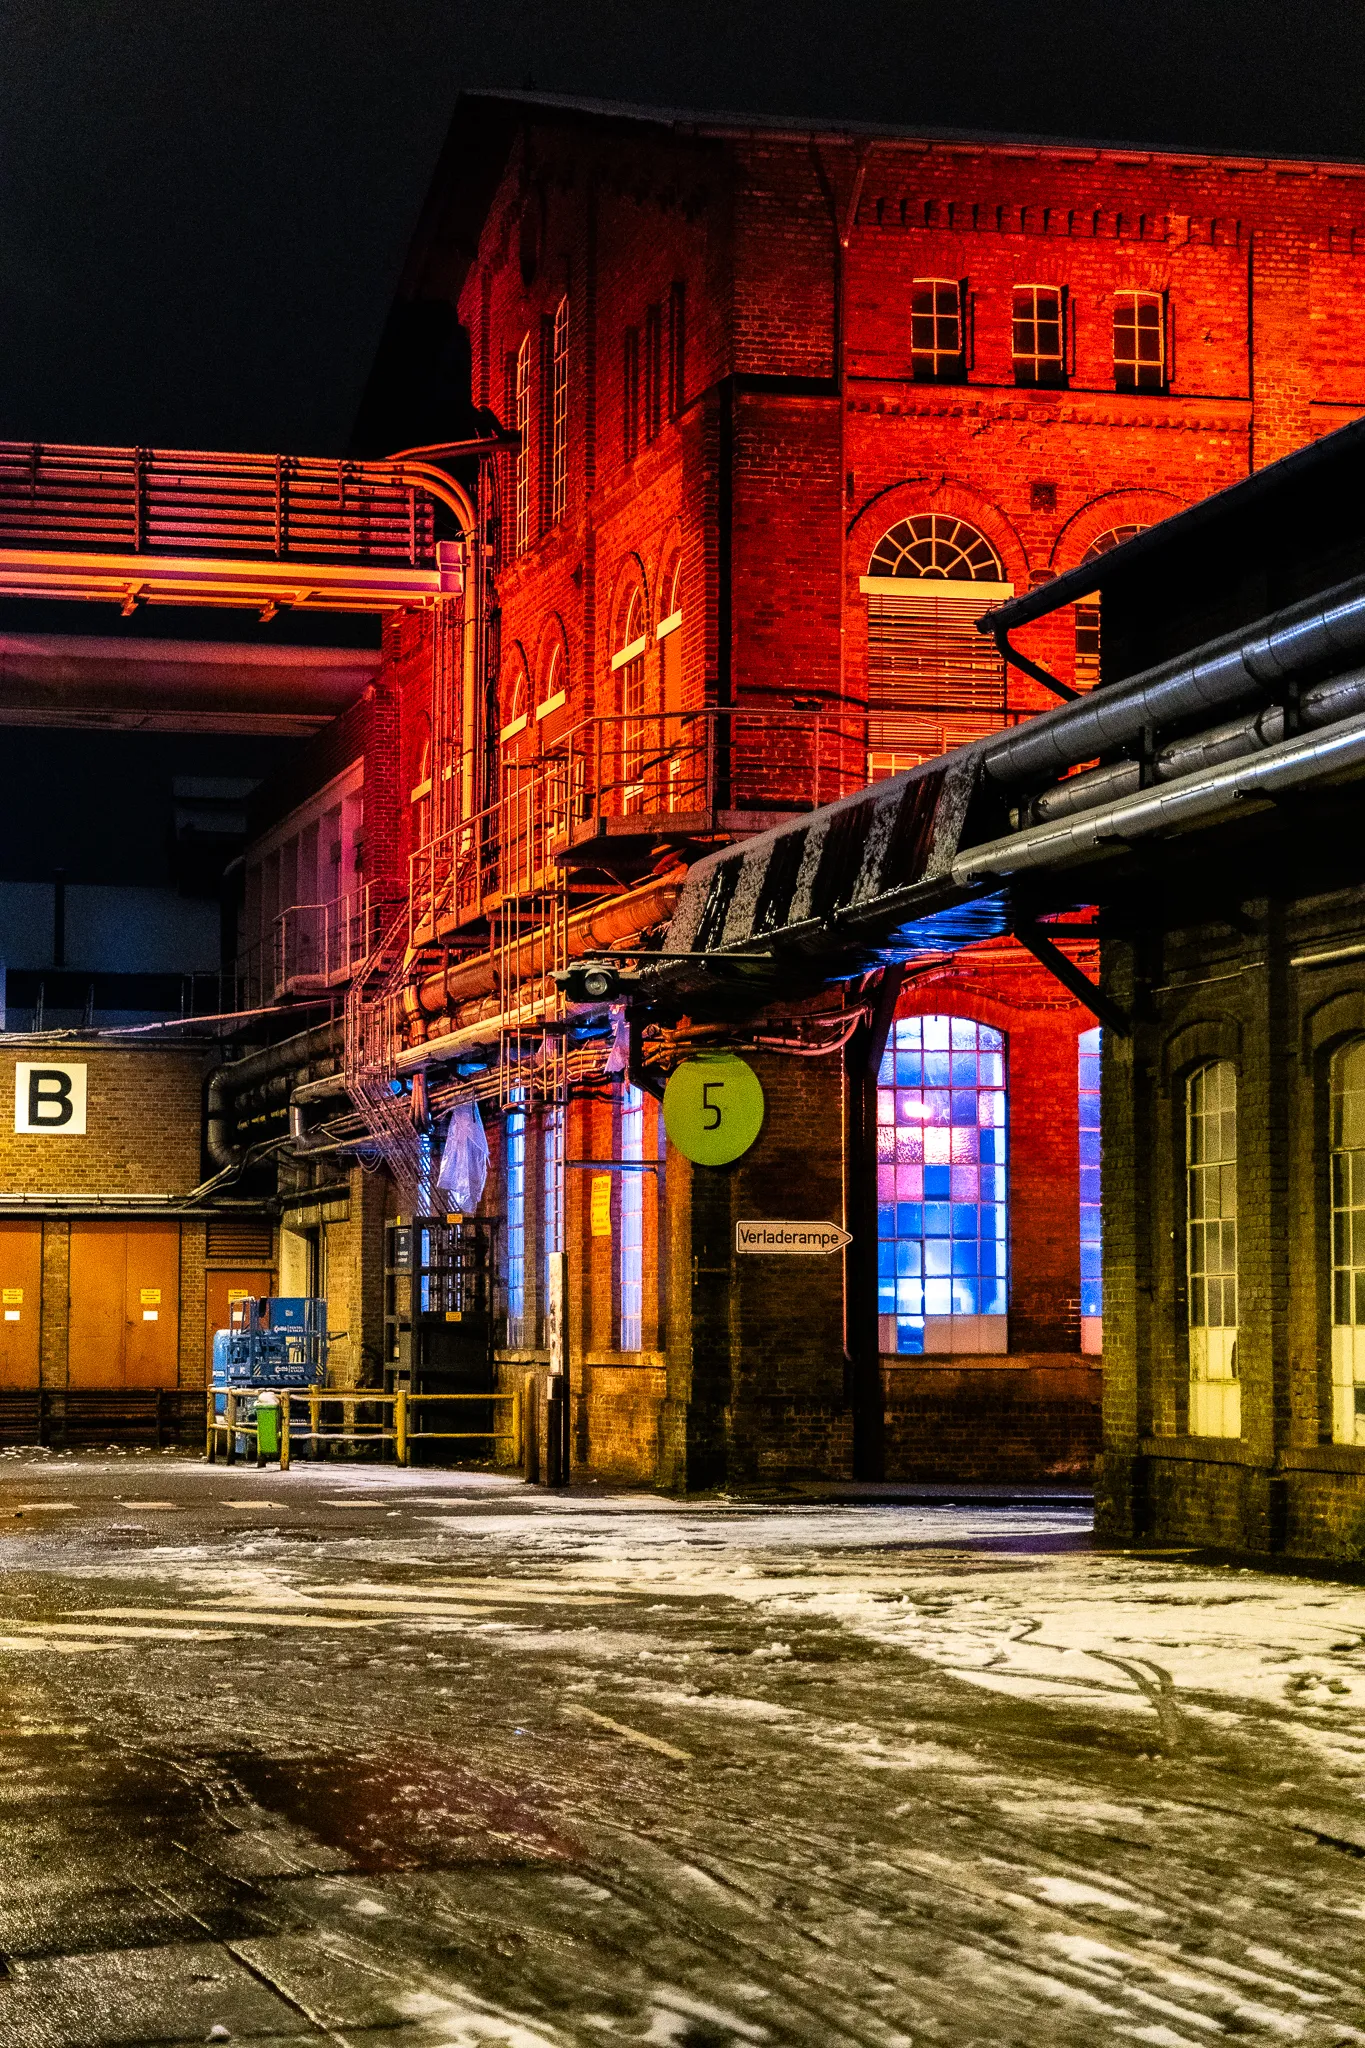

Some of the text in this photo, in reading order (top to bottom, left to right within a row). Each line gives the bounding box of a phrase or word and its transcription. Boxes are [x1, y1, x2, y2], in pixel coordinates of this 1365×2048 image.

[28, 1069, 73, 1126] B
[703, 1082, 724, 1130] 5
[740, 1229, 839, 1248] Verladerampe
